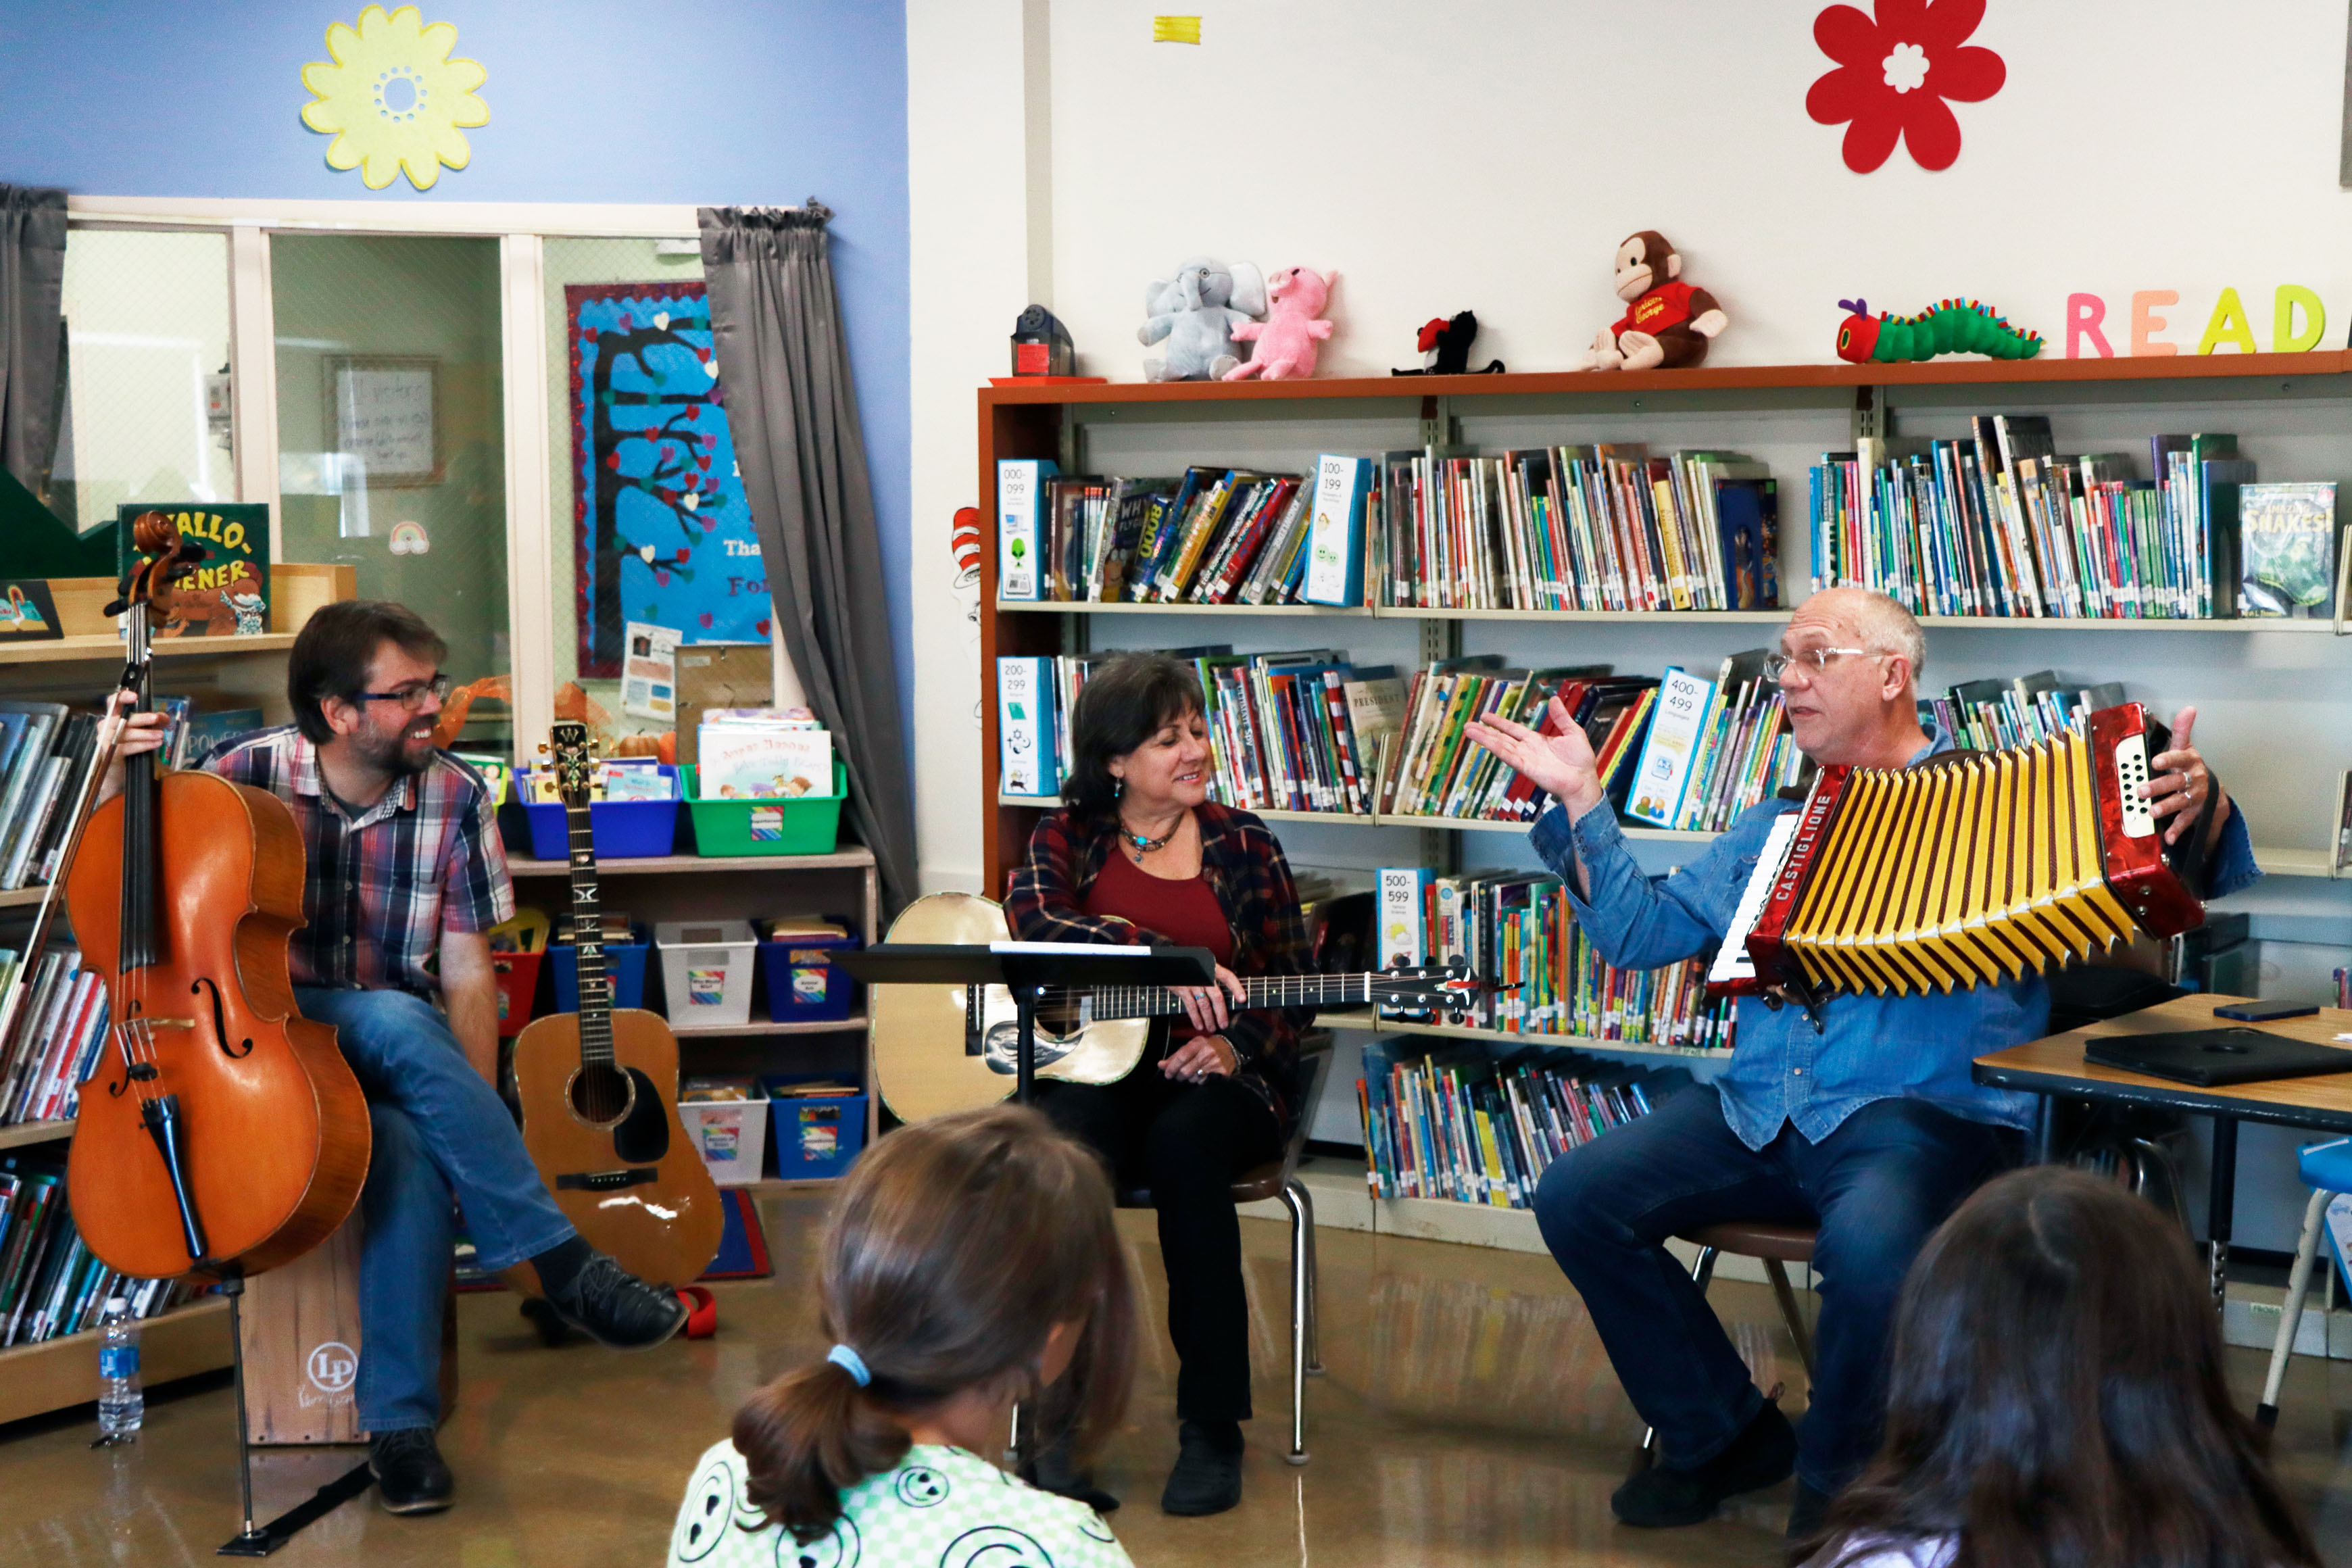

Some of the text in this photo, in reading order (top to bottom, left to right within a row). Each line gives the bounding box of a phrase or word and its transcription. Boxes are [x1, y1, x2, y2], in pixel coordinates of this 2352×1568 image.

[1636, 303, 1665, 324] George
[2066, 285, 2326, 360] READ
[1004, 468, 1026, 480] 000-
[1324, 462, 1344, 474] 100-
[1006, 484, 1025, 494] 099
[1324, 479, 1342, 490] 199
[2264, 504, 2310, 515] AMAZING
[2243, 508, 2334, 533] SNAKES!
[1225, 519, 1243, 543] WORLD
[1209, 542, 1230, 571] RECORDS
[1219, 541, 1240, 570] RECORDS
[1004, 665, 1027, 675] 200-
[1007, 679, 1026, 690] 299
[1671, 679, 1698, 695] 400-
[1354, 693, 1400, 708] PRESIDENT
[1669, 695, 1693, 712] 499
[1775, 794, 1832, 902] CASTIGLIONE
[1386, 875, 1411, 887] 500-
[1388, 891, 1409, 902] 599
[316, 1352, 353, 1385] LP
